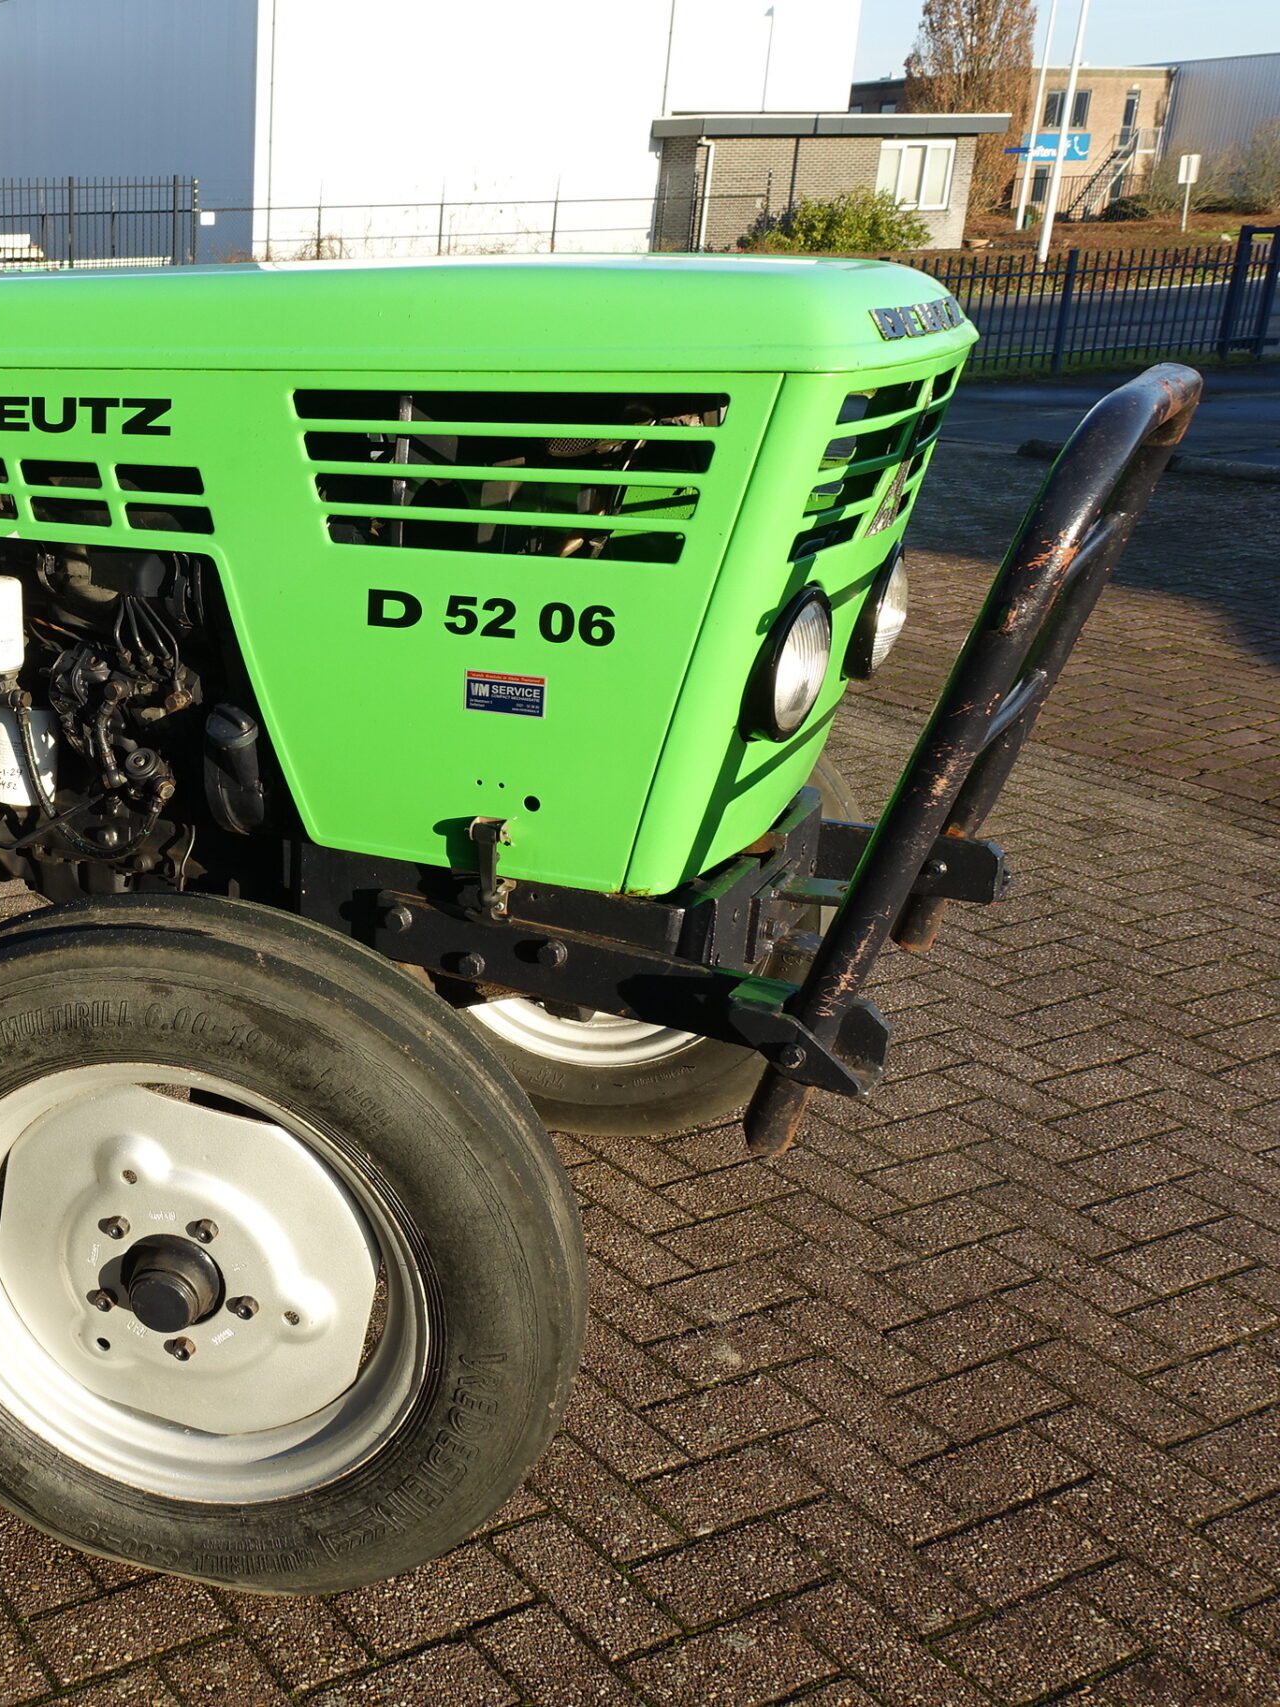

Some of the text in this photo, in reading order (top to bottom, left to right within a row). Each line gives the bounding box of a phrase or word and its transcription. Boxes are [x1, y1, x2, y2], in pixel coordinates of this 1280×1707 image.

[368, 589, 615, 646] D 52 06
[491, 684, 541, 698] SERVICE
[0, 1001, 134, 1044] MULTIRILL
[374, 1352, 507, 1532] VREDESTEIN
